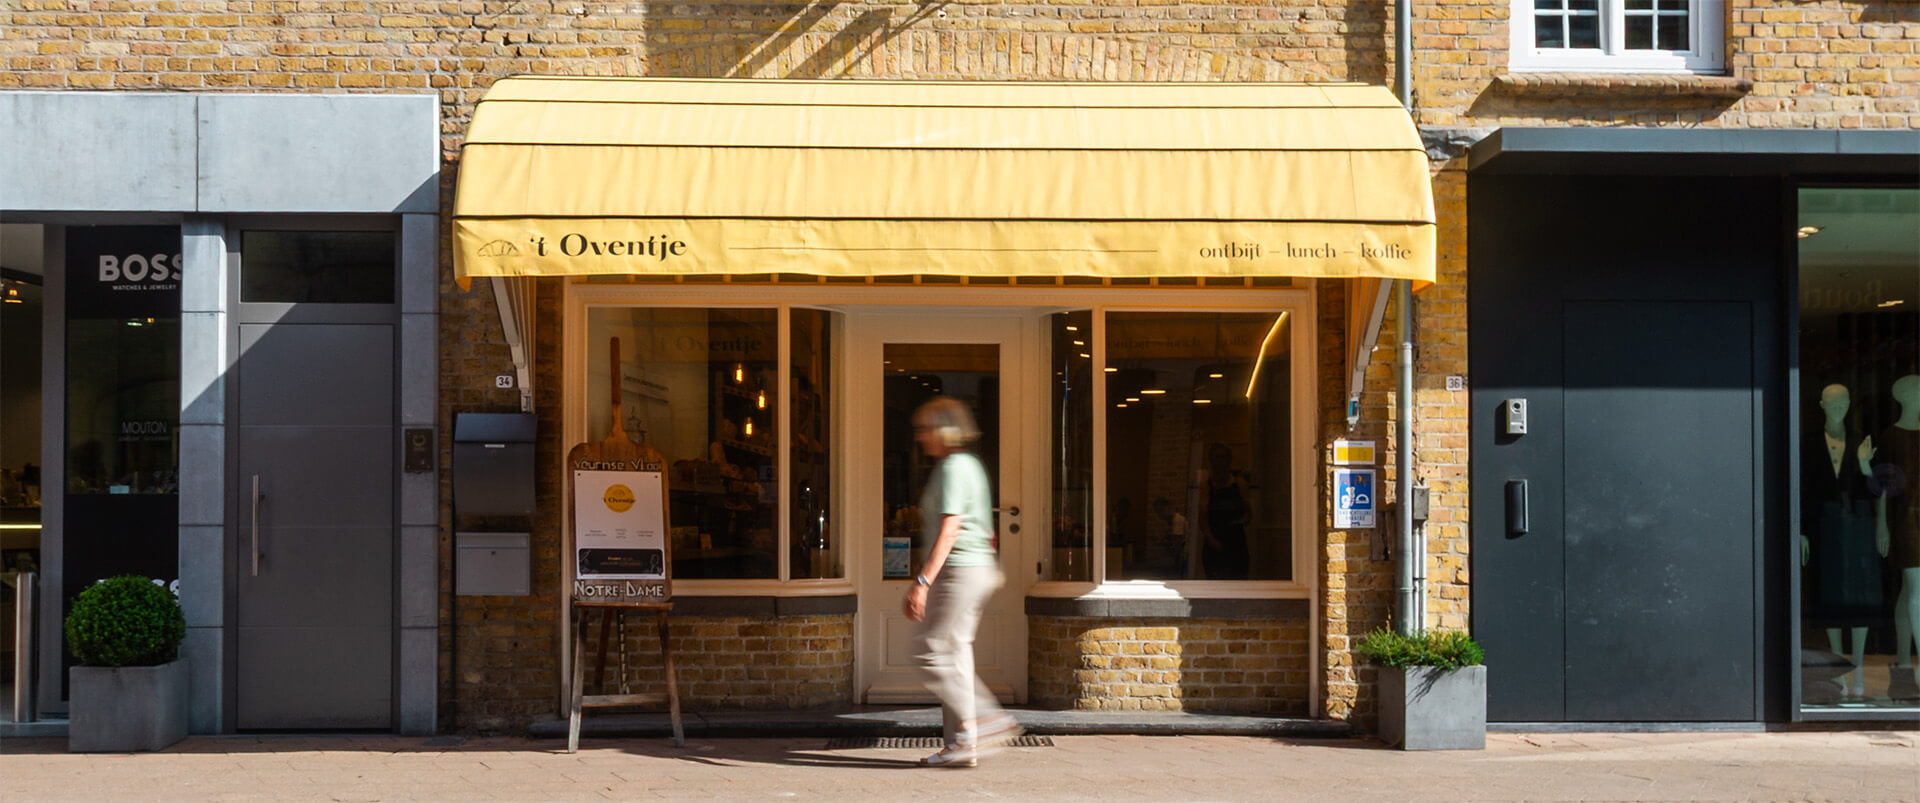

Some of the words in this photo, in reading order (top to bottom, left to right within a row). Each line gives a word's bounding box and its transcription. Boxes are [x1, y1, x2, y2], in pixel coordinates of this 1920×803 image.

[560, 233, 688, 262] Oventje
[1199, 242, 1261, 260] ontbijt
[1287, 242, 1337, 259] lunch
[1361, 242, 1413, 260] koffie
[99, 253, 182, 281] BOSS
[498, 377, 510, 386] 34
[1448, 378, 1461, 389] 36
[122, 421, 167, 434] MOUTON
